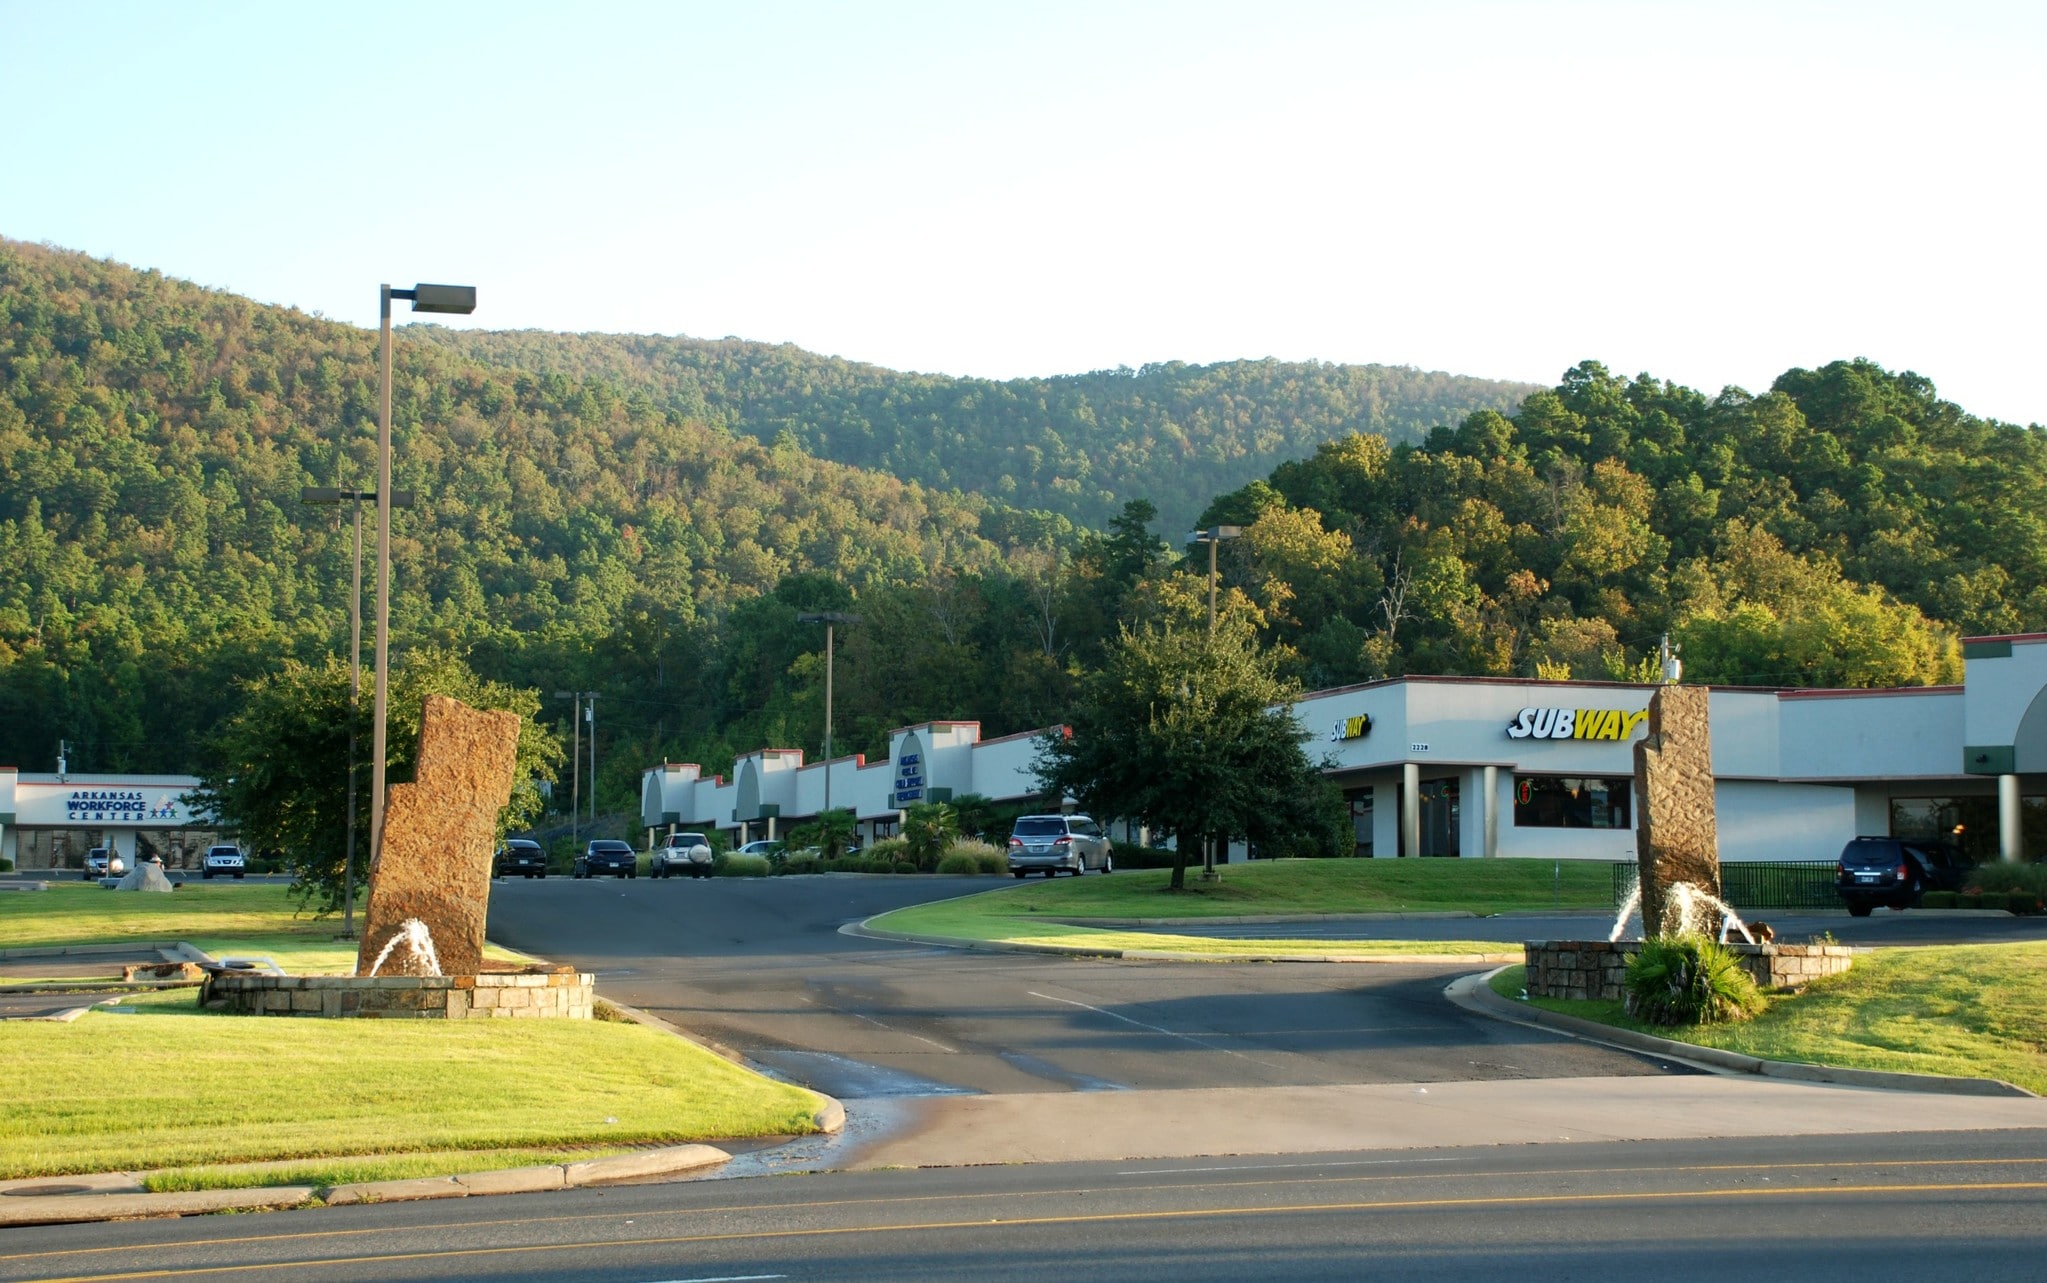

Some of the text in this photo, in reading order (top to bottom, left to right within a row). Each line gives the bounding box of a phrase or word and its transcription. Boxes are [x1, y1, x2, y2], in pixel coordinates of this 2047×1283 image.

[1331, 713, 1368, 741] SUBWAY
[1507, 708, 1649, 741] SUBWAY
[72, 791, 143, 800] ARKANSAS
[67, 801, 146, 811] WORKFORCE
[69, 812, 143, 820] CENTER
